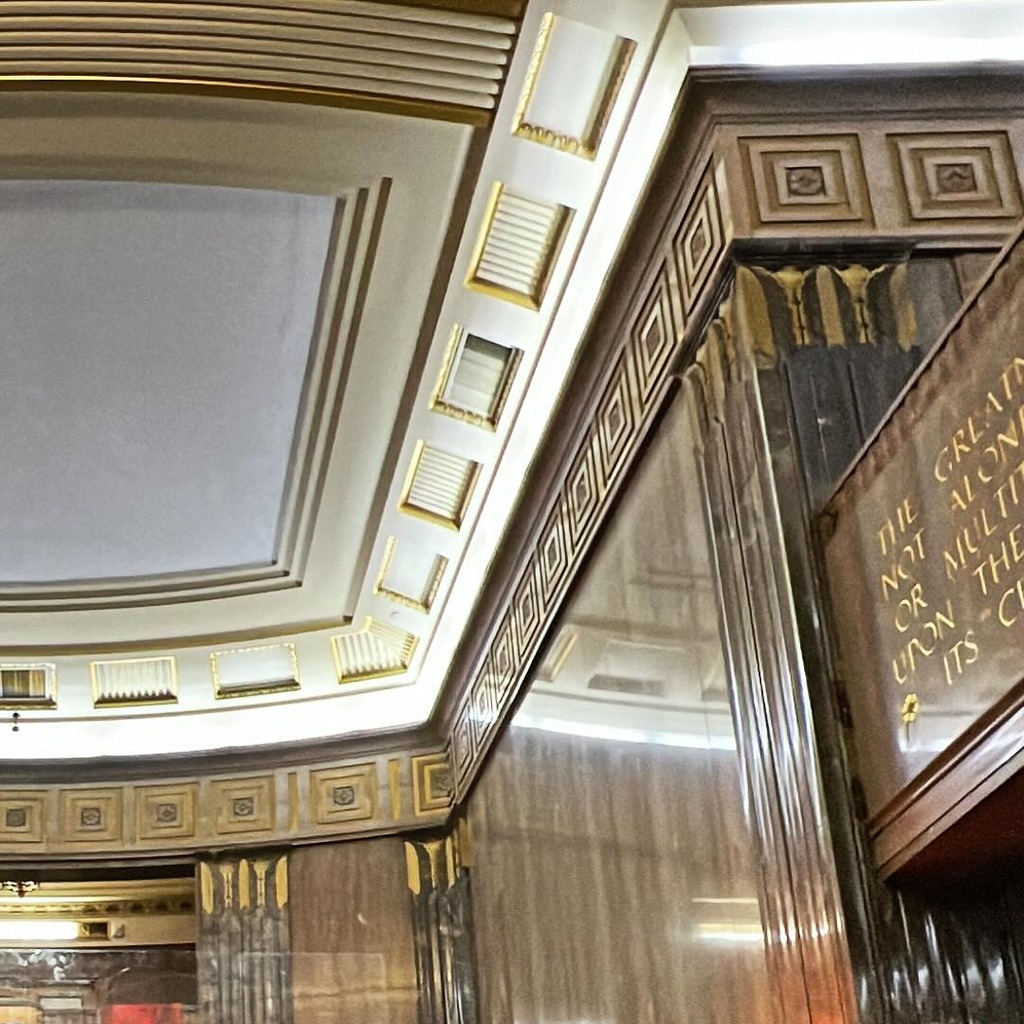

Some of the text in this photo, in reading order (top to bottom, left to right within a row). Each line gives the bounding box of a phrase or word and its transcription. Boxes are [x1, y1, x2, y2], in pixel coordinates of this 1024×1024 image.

[879, 498, 919, 556] THE
[881, 527, 926, 601] NOT
[892, 523, 1024, 685] UPON THE
[895, 583, 928, 633] OR
[943, 629, 979, 686] ITS
